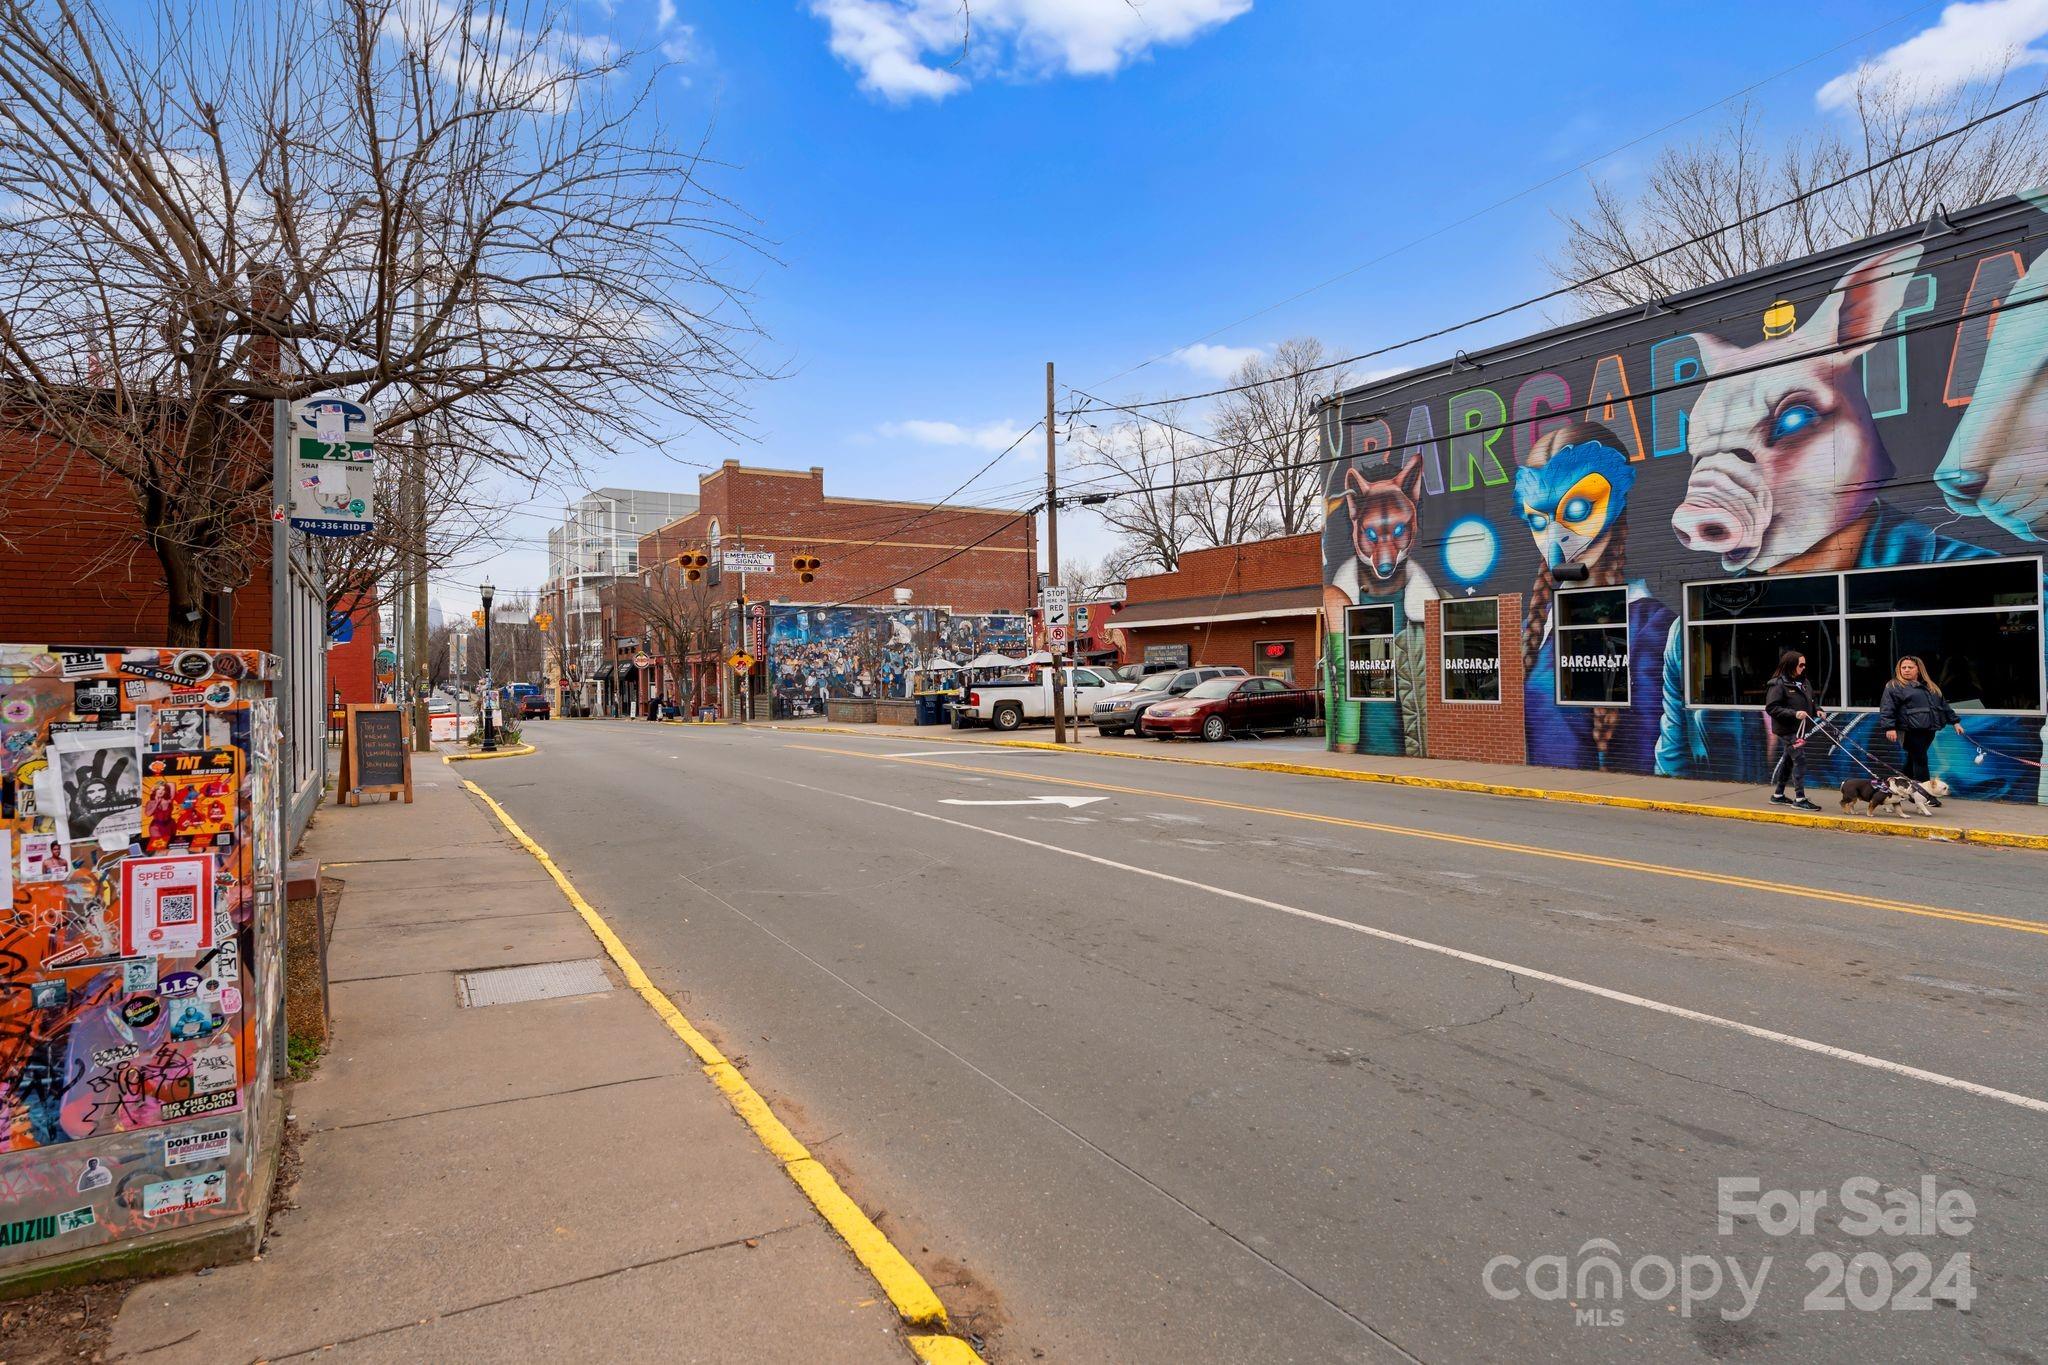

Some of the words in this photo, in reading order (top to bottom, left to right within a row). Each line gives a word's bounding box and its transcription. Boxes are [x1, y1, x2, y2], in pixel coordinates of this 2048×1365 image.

[323, 442, 351, 460] 23
[299, 520, 366, 531] 704-336-RIDE
[76, 694, 118, 708] CBD
[176, 756, 202, 770] TNT
[138, 871, 174, 881] SPEED
[183, 1096, 209, 1108] CHEF
[211, 1091, 236, 1103] DOG
[190, 1098, 233, 1113] COOKIN
[167, 1136, 199, 1149] DON'T
[199, 1131, 228, 1144] READ
